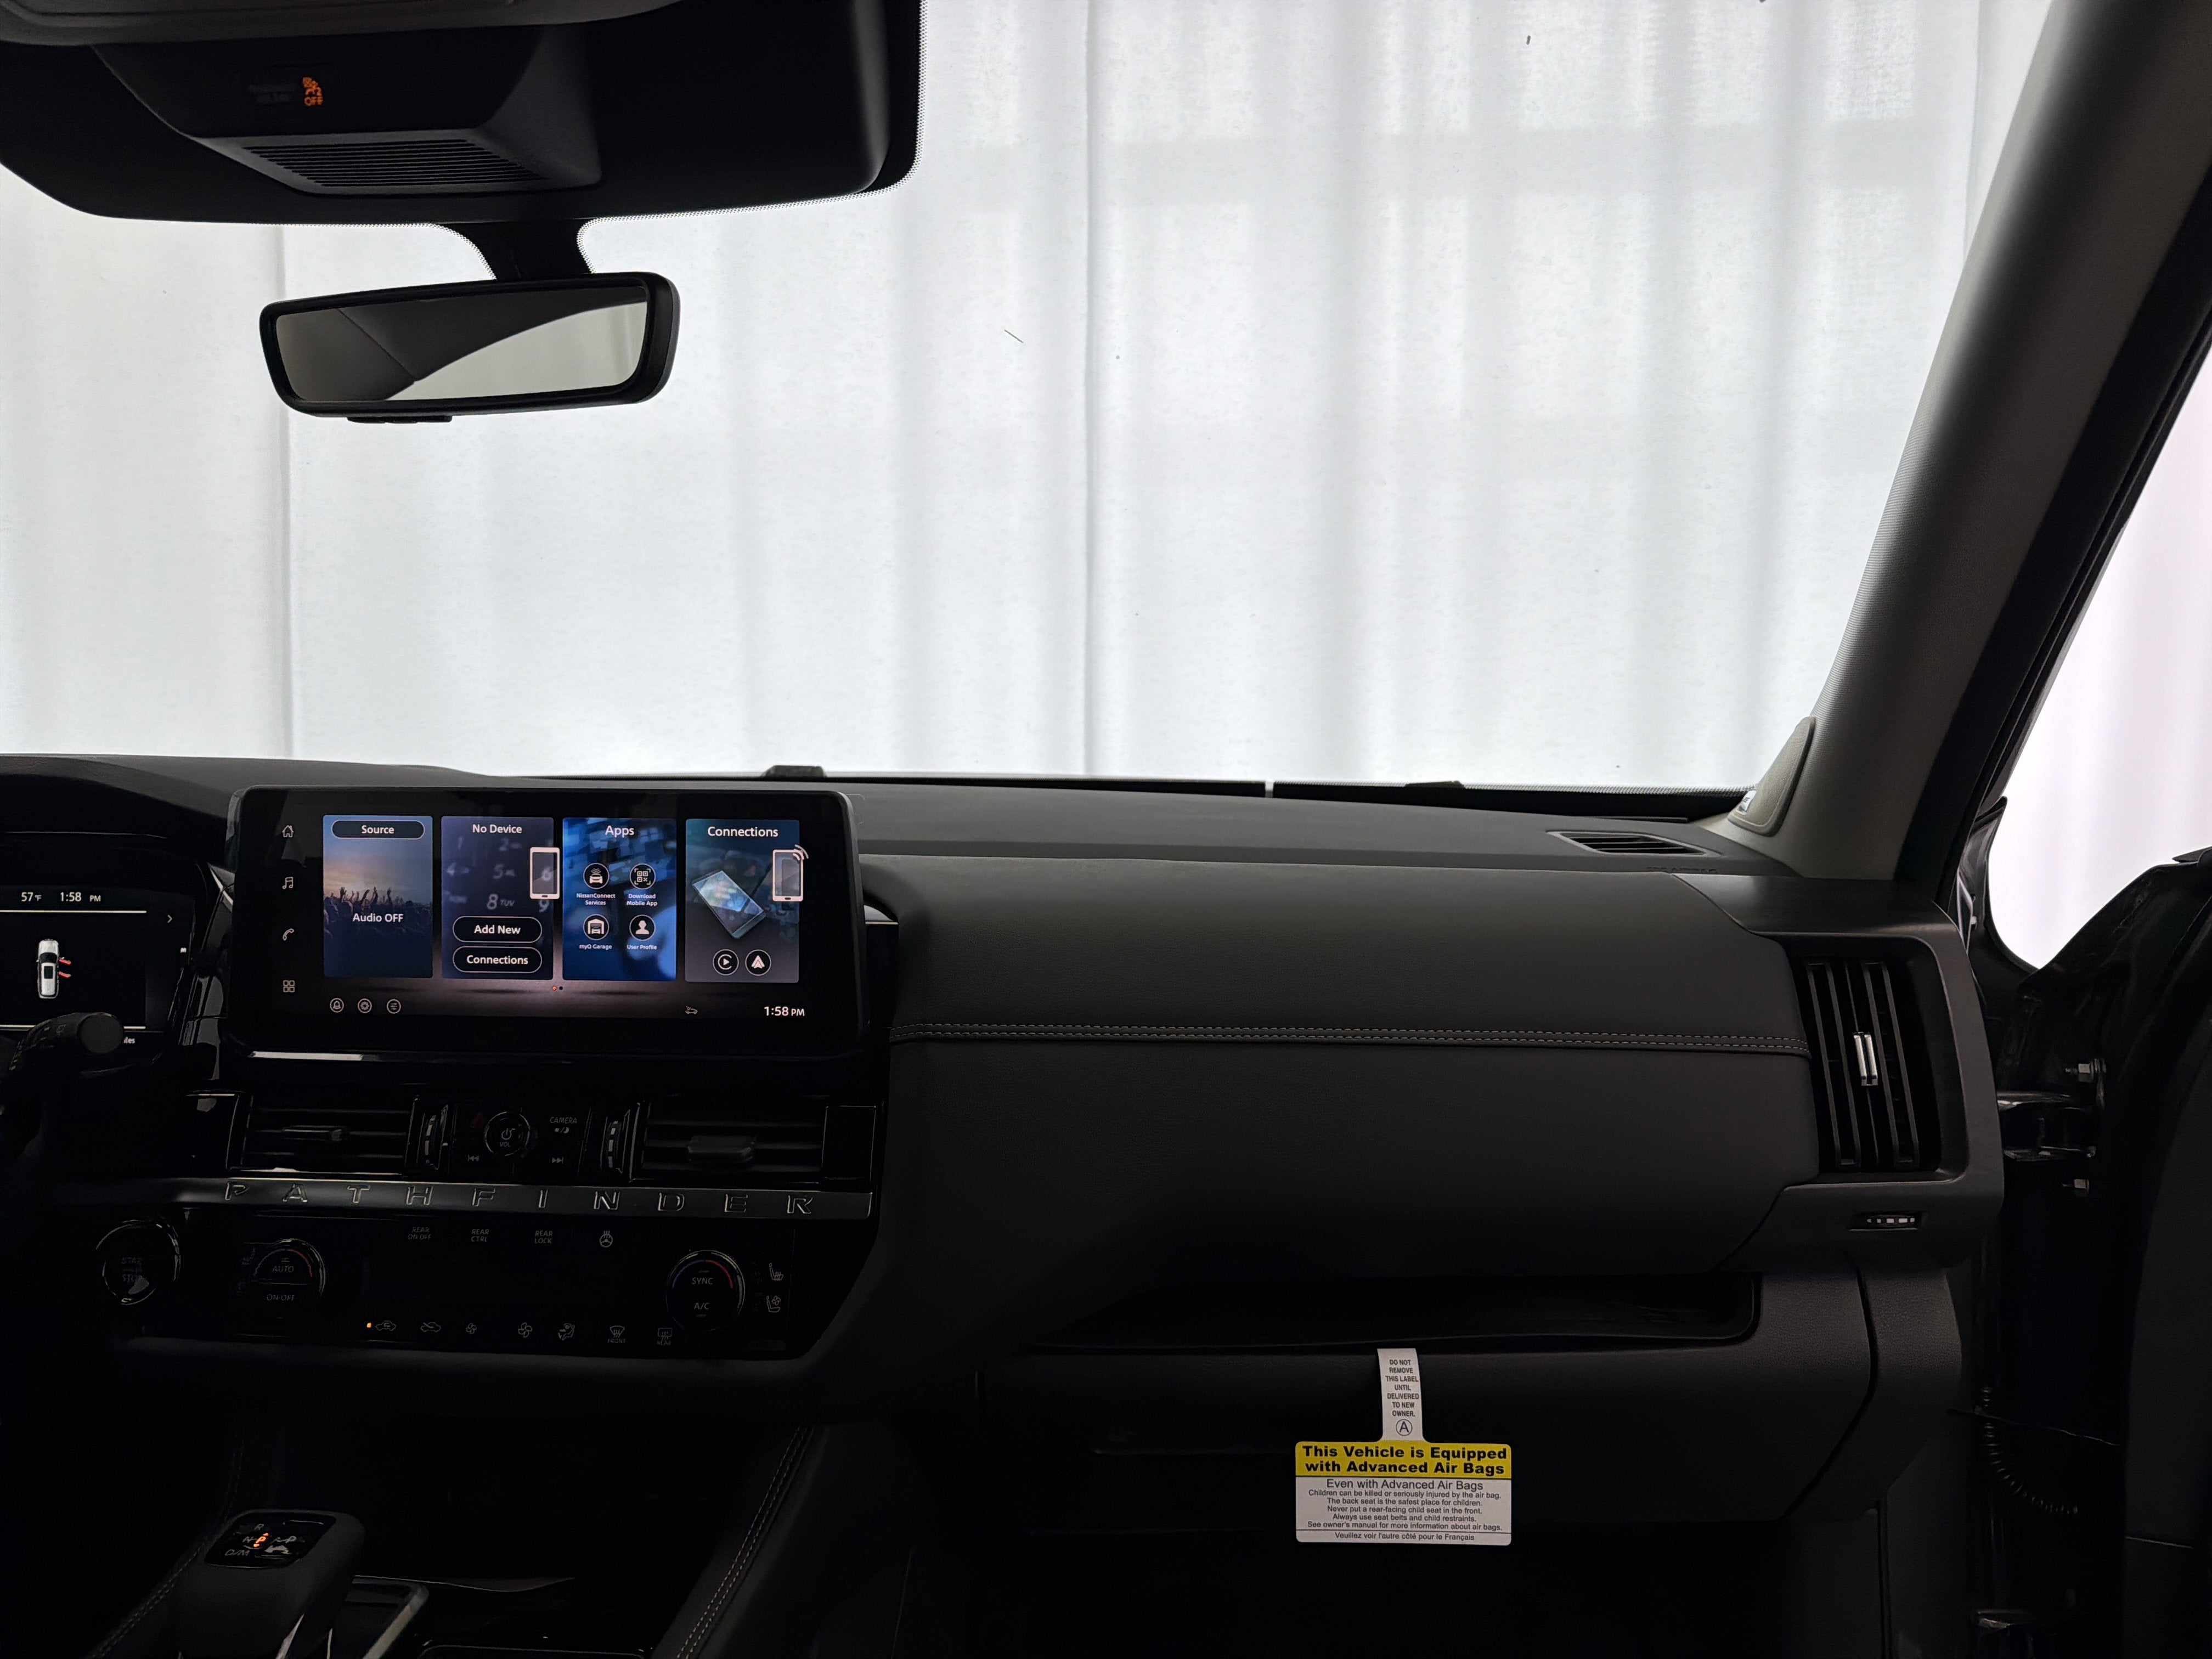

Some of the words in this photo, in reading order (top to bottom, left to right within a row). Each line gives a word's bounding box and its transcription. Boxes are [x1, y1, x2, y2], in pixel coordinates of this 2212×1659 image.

[362, 824, 394, 834] Source
[472, 824, 487, 833] No
[490, 824, 522, 833] Device
[605, 825, 634, 837] Apps
[707, 826, 778, 837] Connections
[60, 892, 82, 902] 1:58
[487, 894, 499, 910] 8
[353, 913, 382, 923] Audio
[385, 913, 404, 923] OFF
[474, 924, 493, 934] Add
[496, 924, 521, 934] New
[466, 955, 528, 965] Connections
[764, 1006, 789, 1017] 1:58
[791, 1008, 805, 1017] PM
[225, 1181, 814, 1215] PATHFINDER
[691, 1277, 713, 1285] SYNC
[1302, 1446, 1338, 1457] This
[1344, 1446, 1404, 1457] Vehicle
[1410, 1447, 1424, 1458] is
[1431, 1447, 1506, 1461] Equipped
[1305, 1460, 1340, 1471] with
[1346, 1461, 1427, 1473] Advanced
[1434, 1462, 1457, 1473] Air
[1464, 1463, 1504, 1476] Bags
[1327, 1479, 1353, 1488] Even
[1357, 1479, 1378, 1488] with
[1381, 1480, 1434, 1489] Advanced
[1437, 1481, 1453, 1489] Air
[1457, 1481, 1483, 1492] Bags
